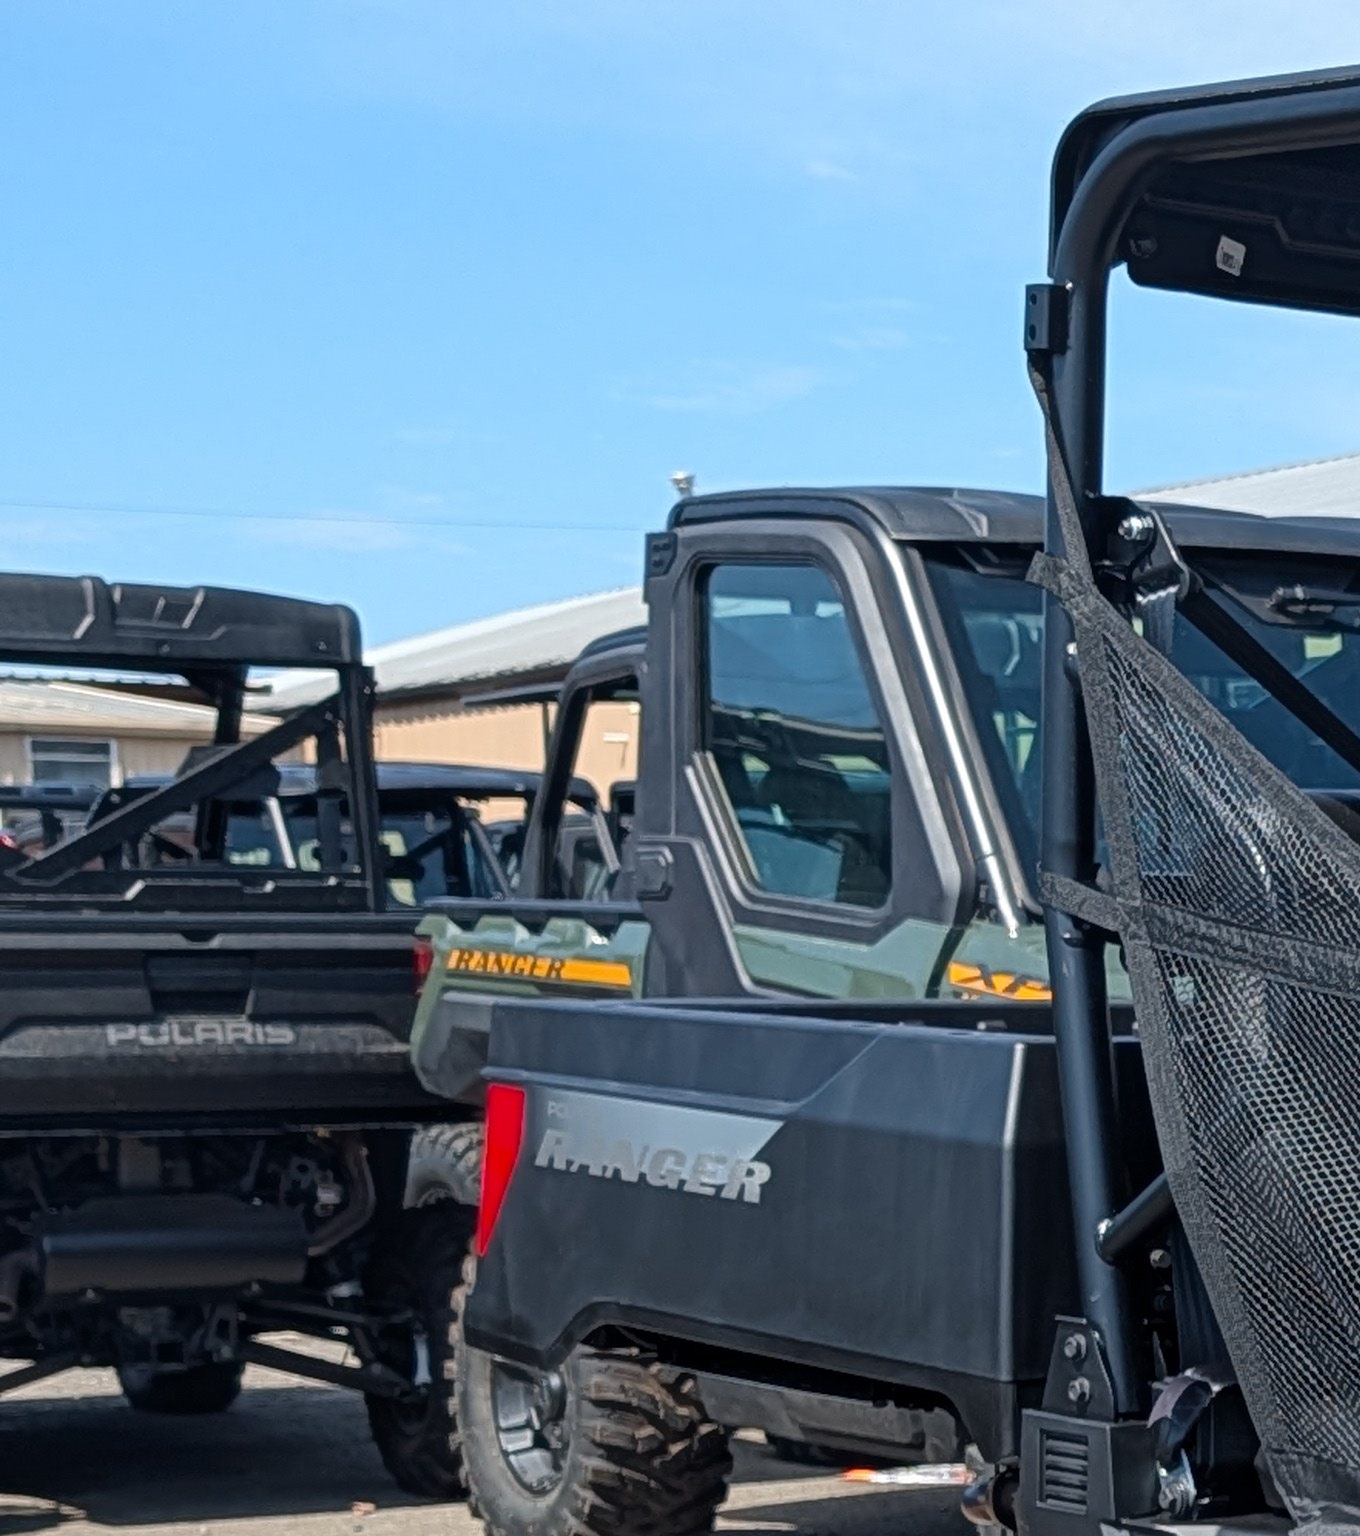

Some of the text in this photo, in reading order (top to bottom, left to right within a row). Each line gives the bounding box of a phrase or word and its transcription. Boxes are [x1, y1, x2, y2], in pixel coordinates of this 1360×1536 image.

[456, 949, 566, 980] RANGER
[106, 1022, 295, 1046] POLARIS
[535, 1128, 772, 1204] RANGER
